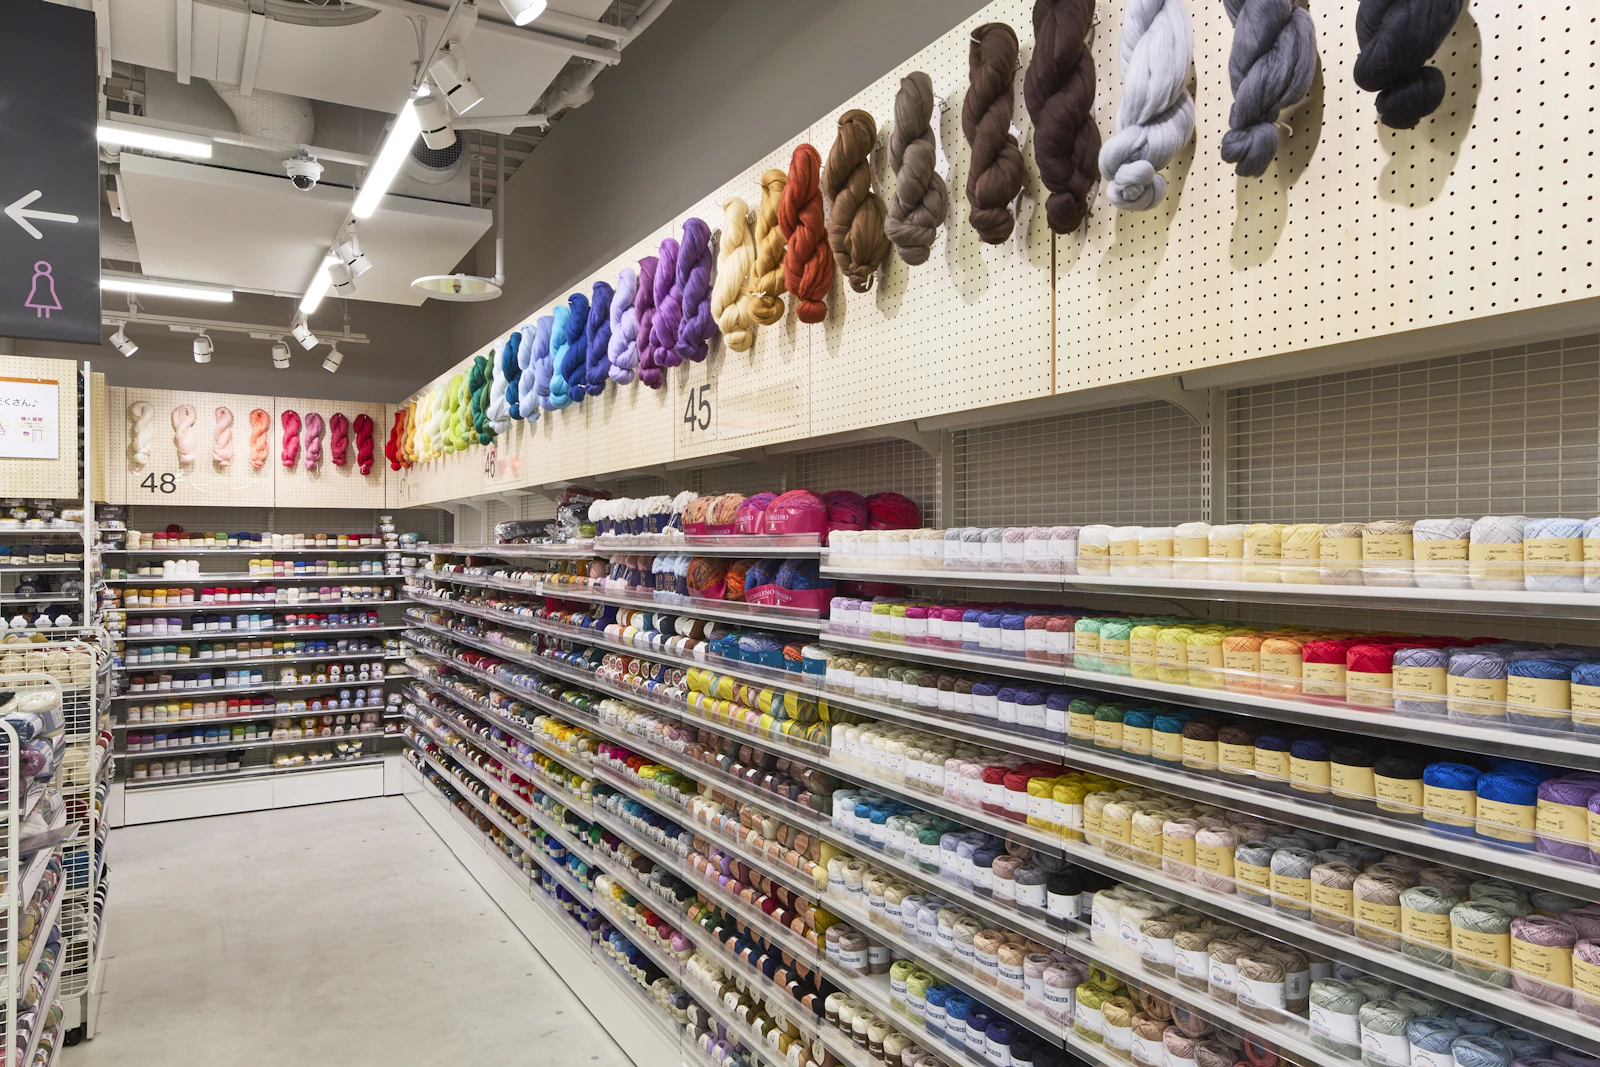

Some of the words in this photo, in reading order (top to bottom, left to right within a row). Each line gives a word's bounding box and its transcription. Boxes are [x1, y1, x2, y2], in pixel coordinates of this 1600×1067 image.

[684, 384, 711, 432] 45
[484, 451, 495, 478] 46
[140, 472, 176, 494] 48
